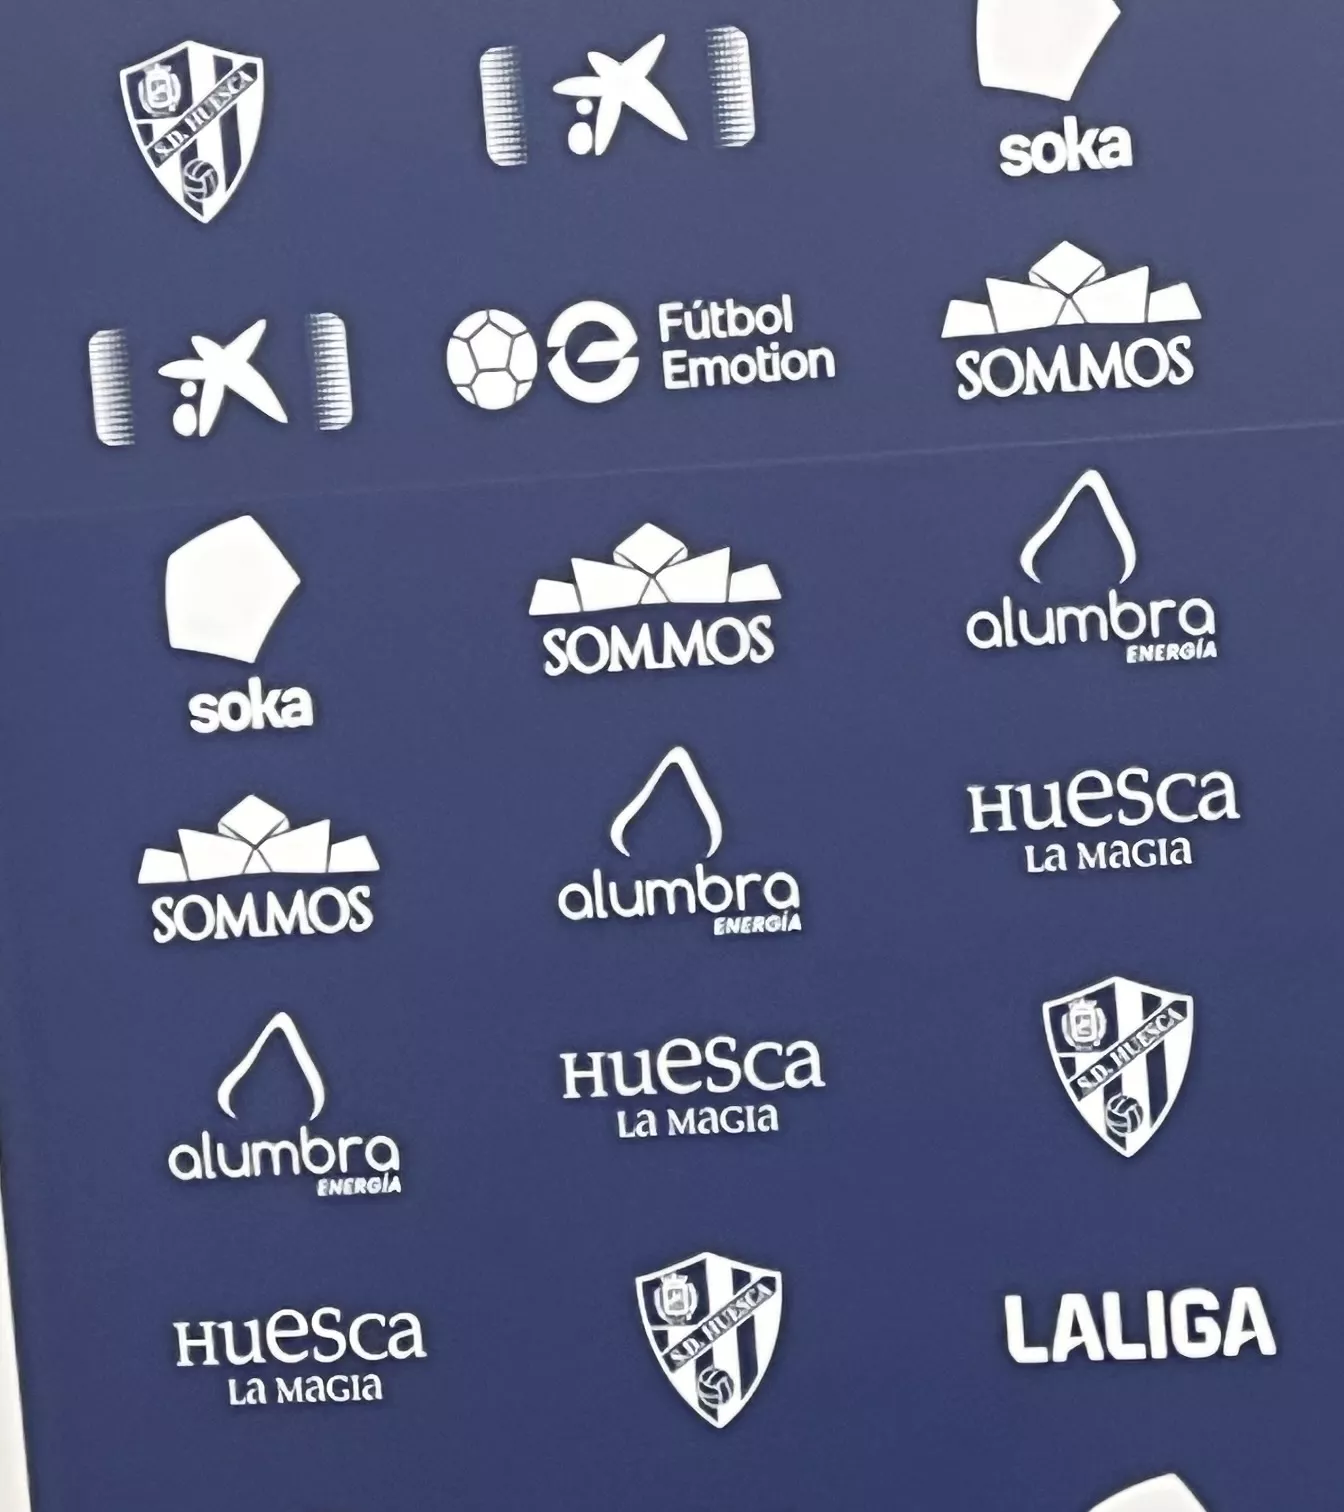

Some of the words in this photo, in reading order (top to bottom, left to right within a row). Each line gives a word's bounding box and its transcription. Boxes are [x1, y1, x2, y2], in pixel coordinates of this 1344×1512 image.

[999, 115, 1133, 177] soka
[658, 293, 794, 343] Fútbol
[662, 341, 836, 390] Emotion
[955, 334, 1194, 401] SOMMOS
[542, 614, 775, 677] SOMMOS
[966, 588, 1216, 649] alumbra
[1126, 637, 1218, 664] ENERGÍA
[188, 676, 314, 734] soka
[151, 885, 374, 944] SOMMOS
[558, 863, 800, 921] alumbra
[713, 909, 802, 936] ENERGÍA
[167, 1125, 400, 1181] alumbra
[316, 1171, 402, 1197] ENERGÍA
[1004, 1286, 1277, 1364] LALIGA
